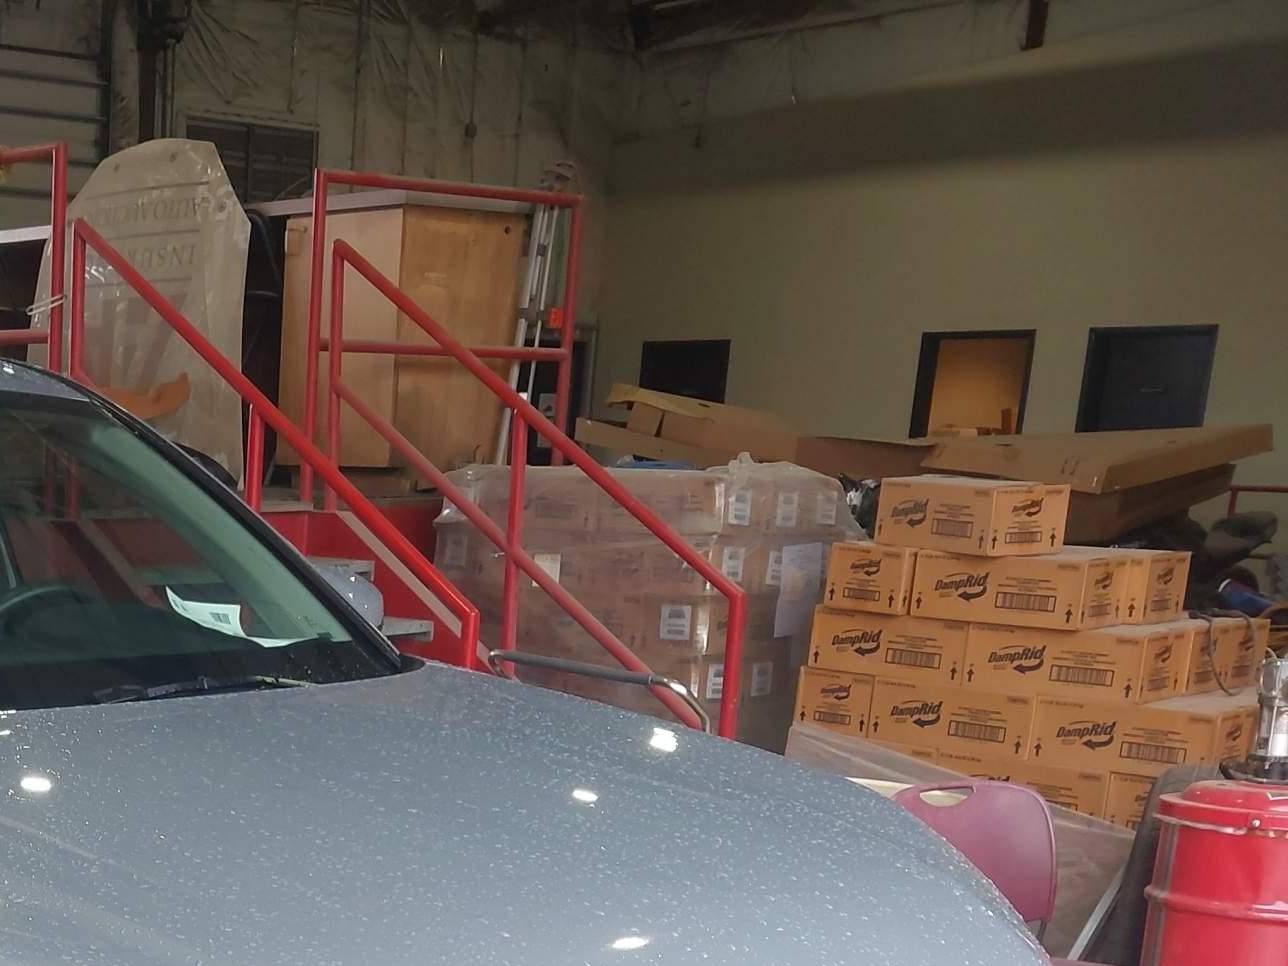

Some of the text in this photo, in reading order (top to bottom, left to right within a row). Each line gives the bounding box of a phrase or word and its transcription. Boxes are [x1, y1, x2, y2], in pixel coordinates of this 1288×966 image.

[934, 572, 990, 591] DampRid
[831, 629, 882, 646] DampRid
[987, 645, 1047, 664] DampRid
[890, 701, 943, 718] DampRid
[1055, 721, 1117, 739] DampRid
